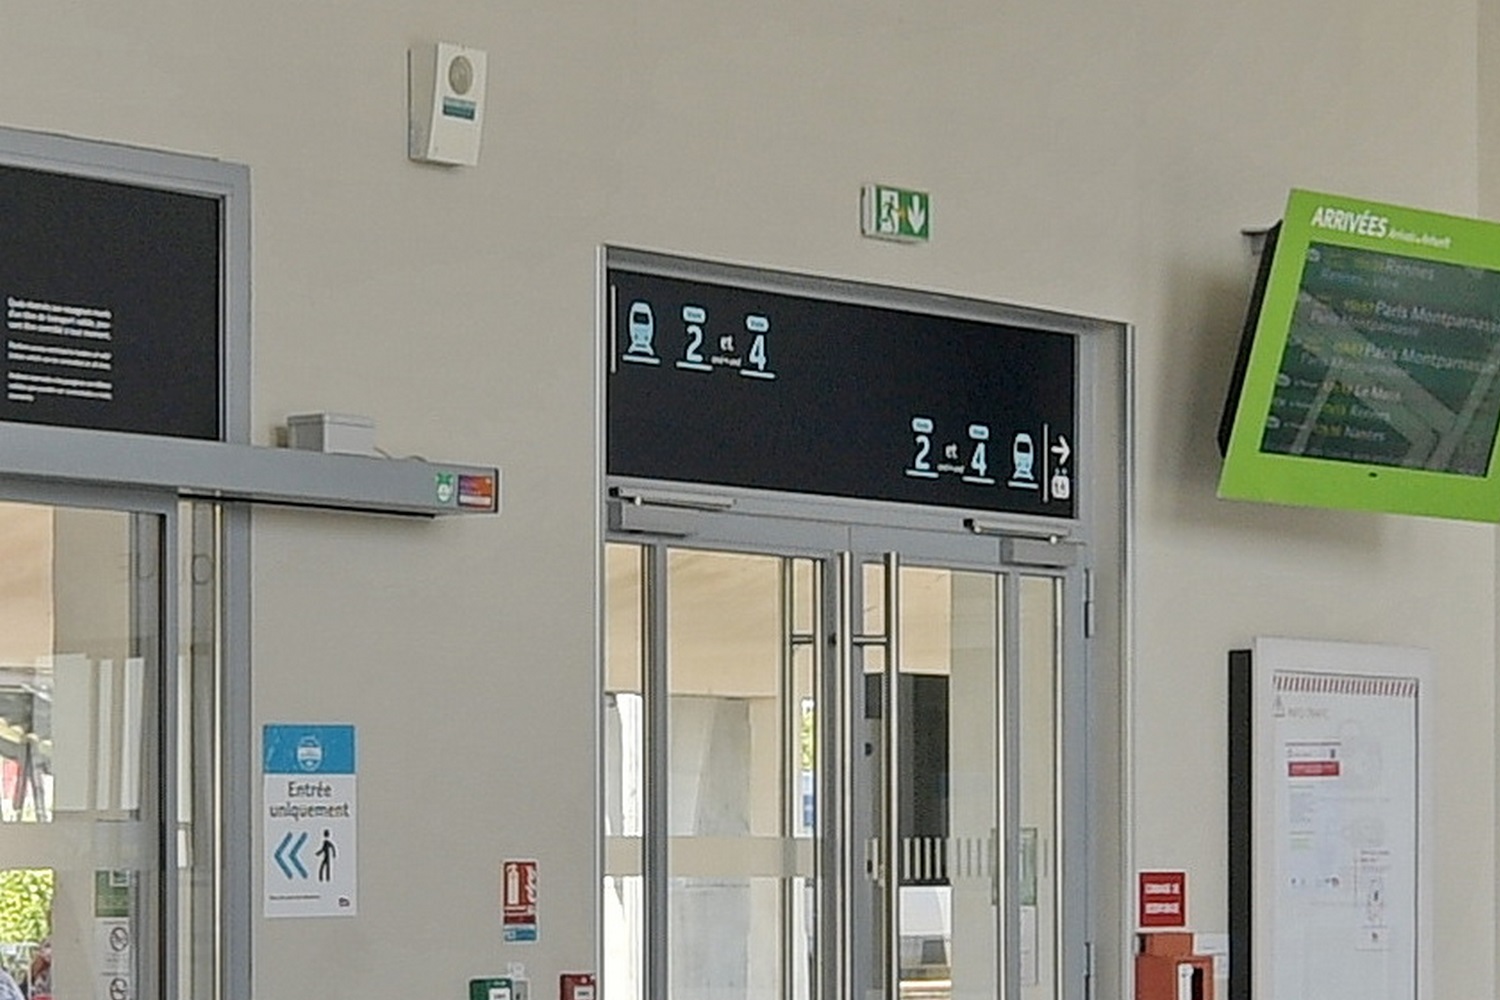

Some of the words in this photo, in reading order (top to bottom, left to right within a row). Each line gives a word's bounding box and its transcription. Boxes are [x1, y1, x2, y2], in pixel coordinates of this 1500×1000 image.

[1310, 206, 1389, 239] ARRIVÉES
[686, 324, 703, 362] 2
[749, 334, 767, 371] 4
[914, 434, 931, 470] 2
[970, 441, 988, 477] 4
[288, 781, 333, 798] Entrée
[269, 802, 351, 821] uniquement
